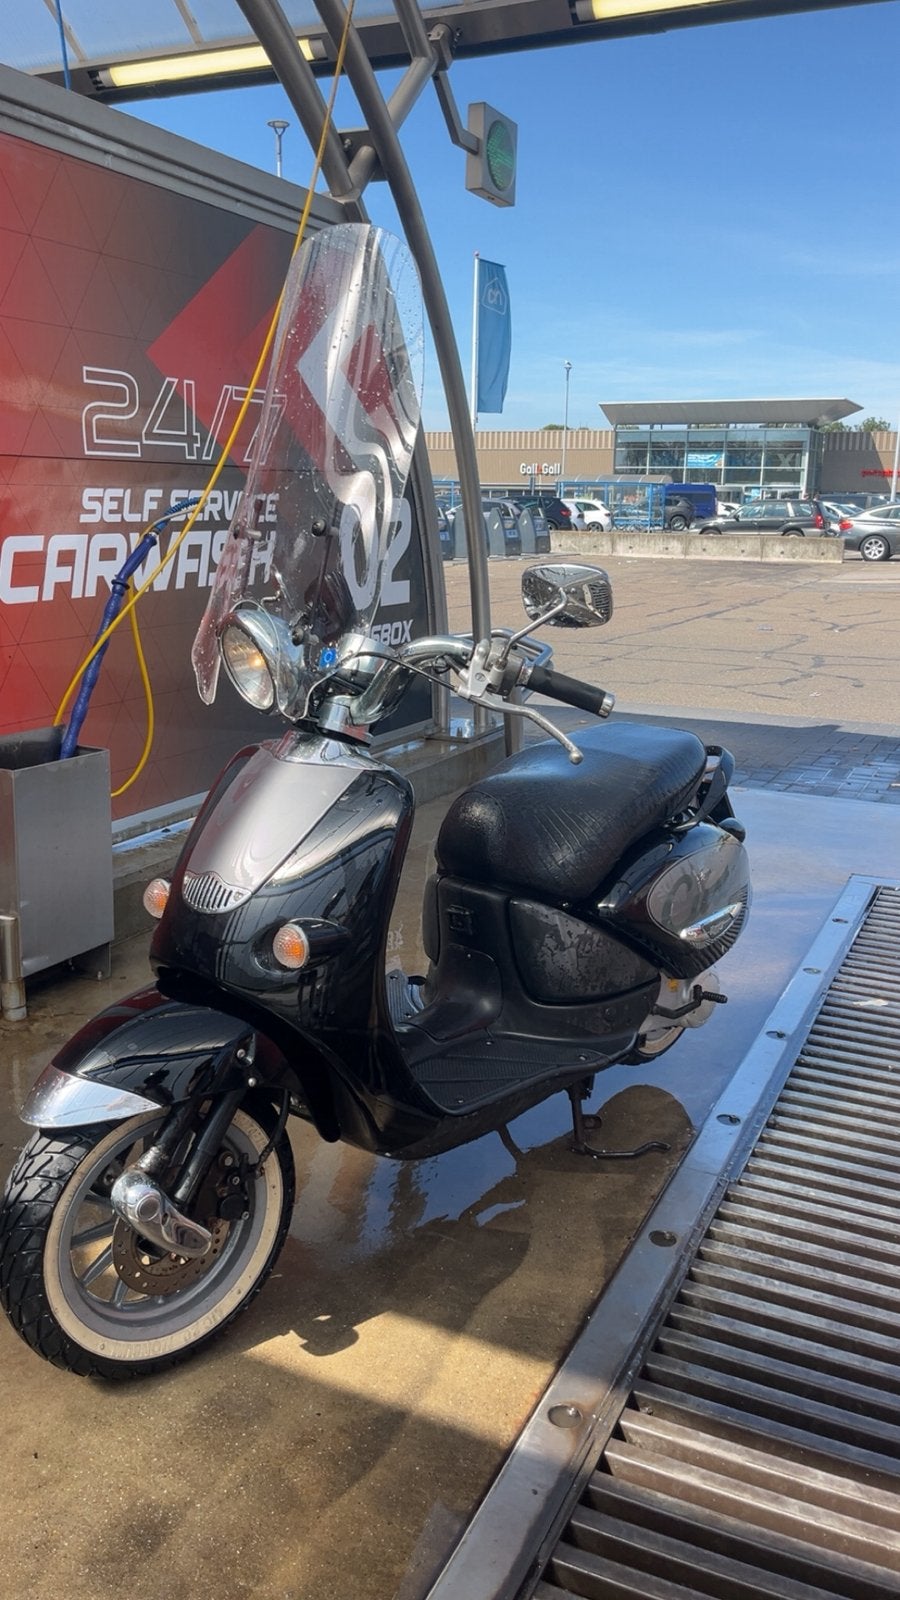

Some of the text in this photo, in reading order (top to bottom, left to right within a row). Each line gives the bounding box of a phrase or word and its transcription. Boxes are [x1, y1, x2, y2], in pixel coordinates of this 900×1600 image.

[82, 365, 287, 466] 24/7
[79, 487, 162, 523] SELF
[339, 497, 412, 611] 02
